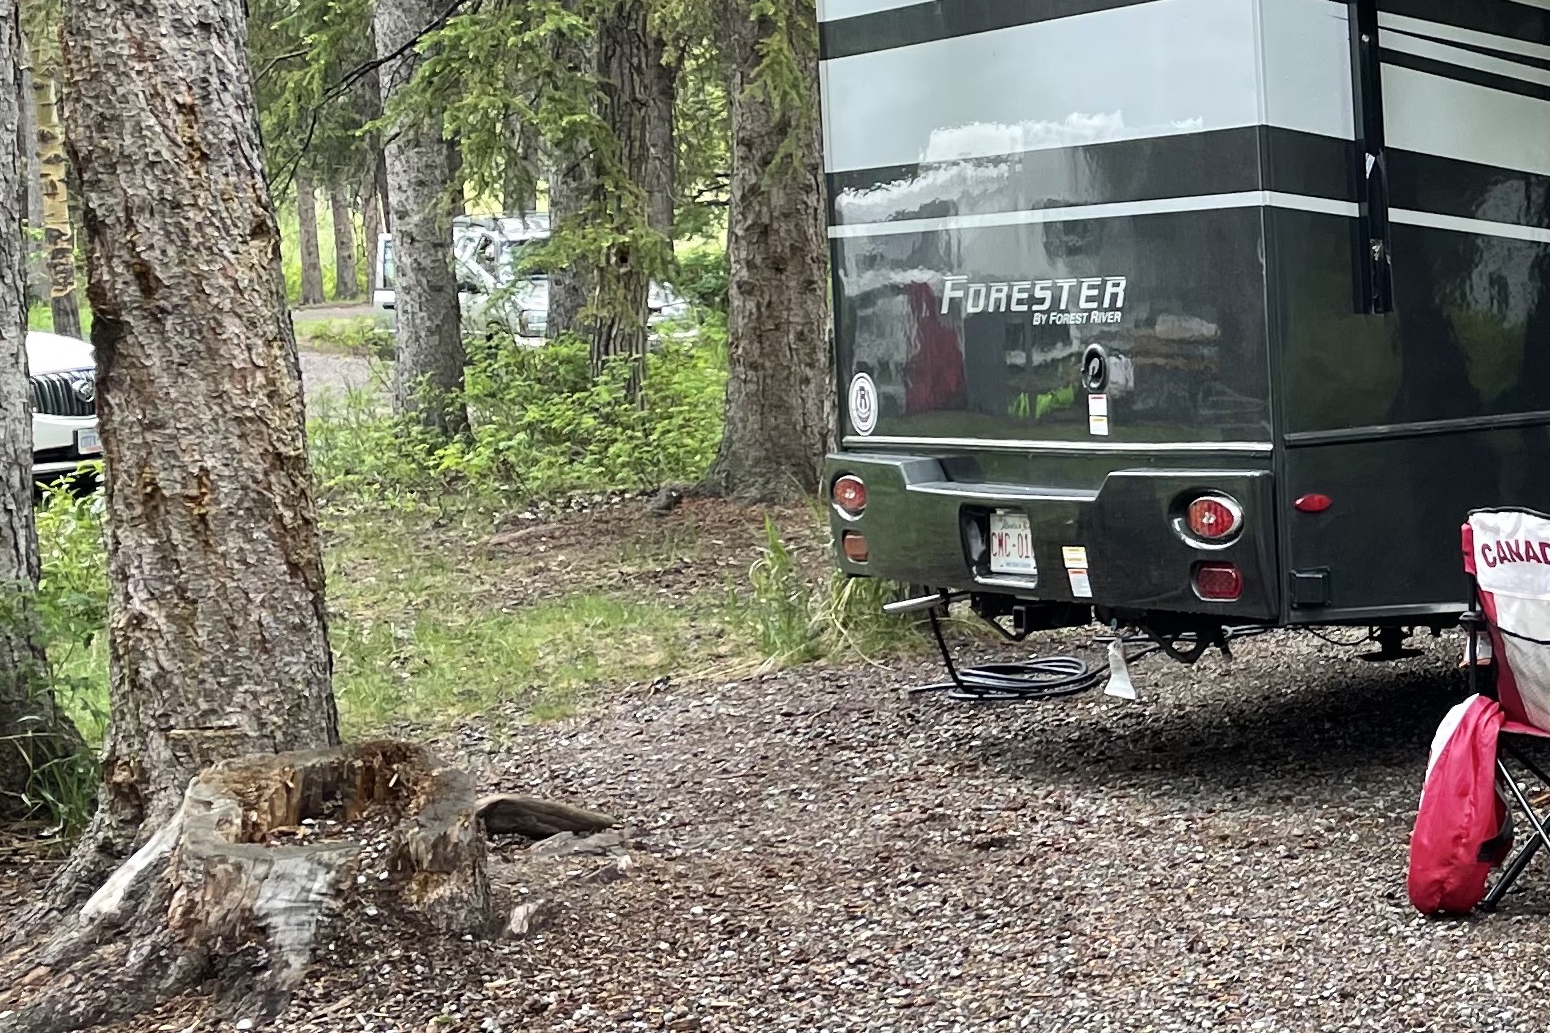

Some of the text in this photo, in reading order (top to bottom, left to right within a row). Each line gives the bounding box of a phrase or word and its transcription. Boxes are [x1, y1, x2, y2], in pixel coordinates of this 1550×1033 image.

[940, 275, 1127, 315] FORESTER
[1032, 310, 1122, 326] BY FOREST RIVER
[991, 532, 1034, 559] CMC-01
